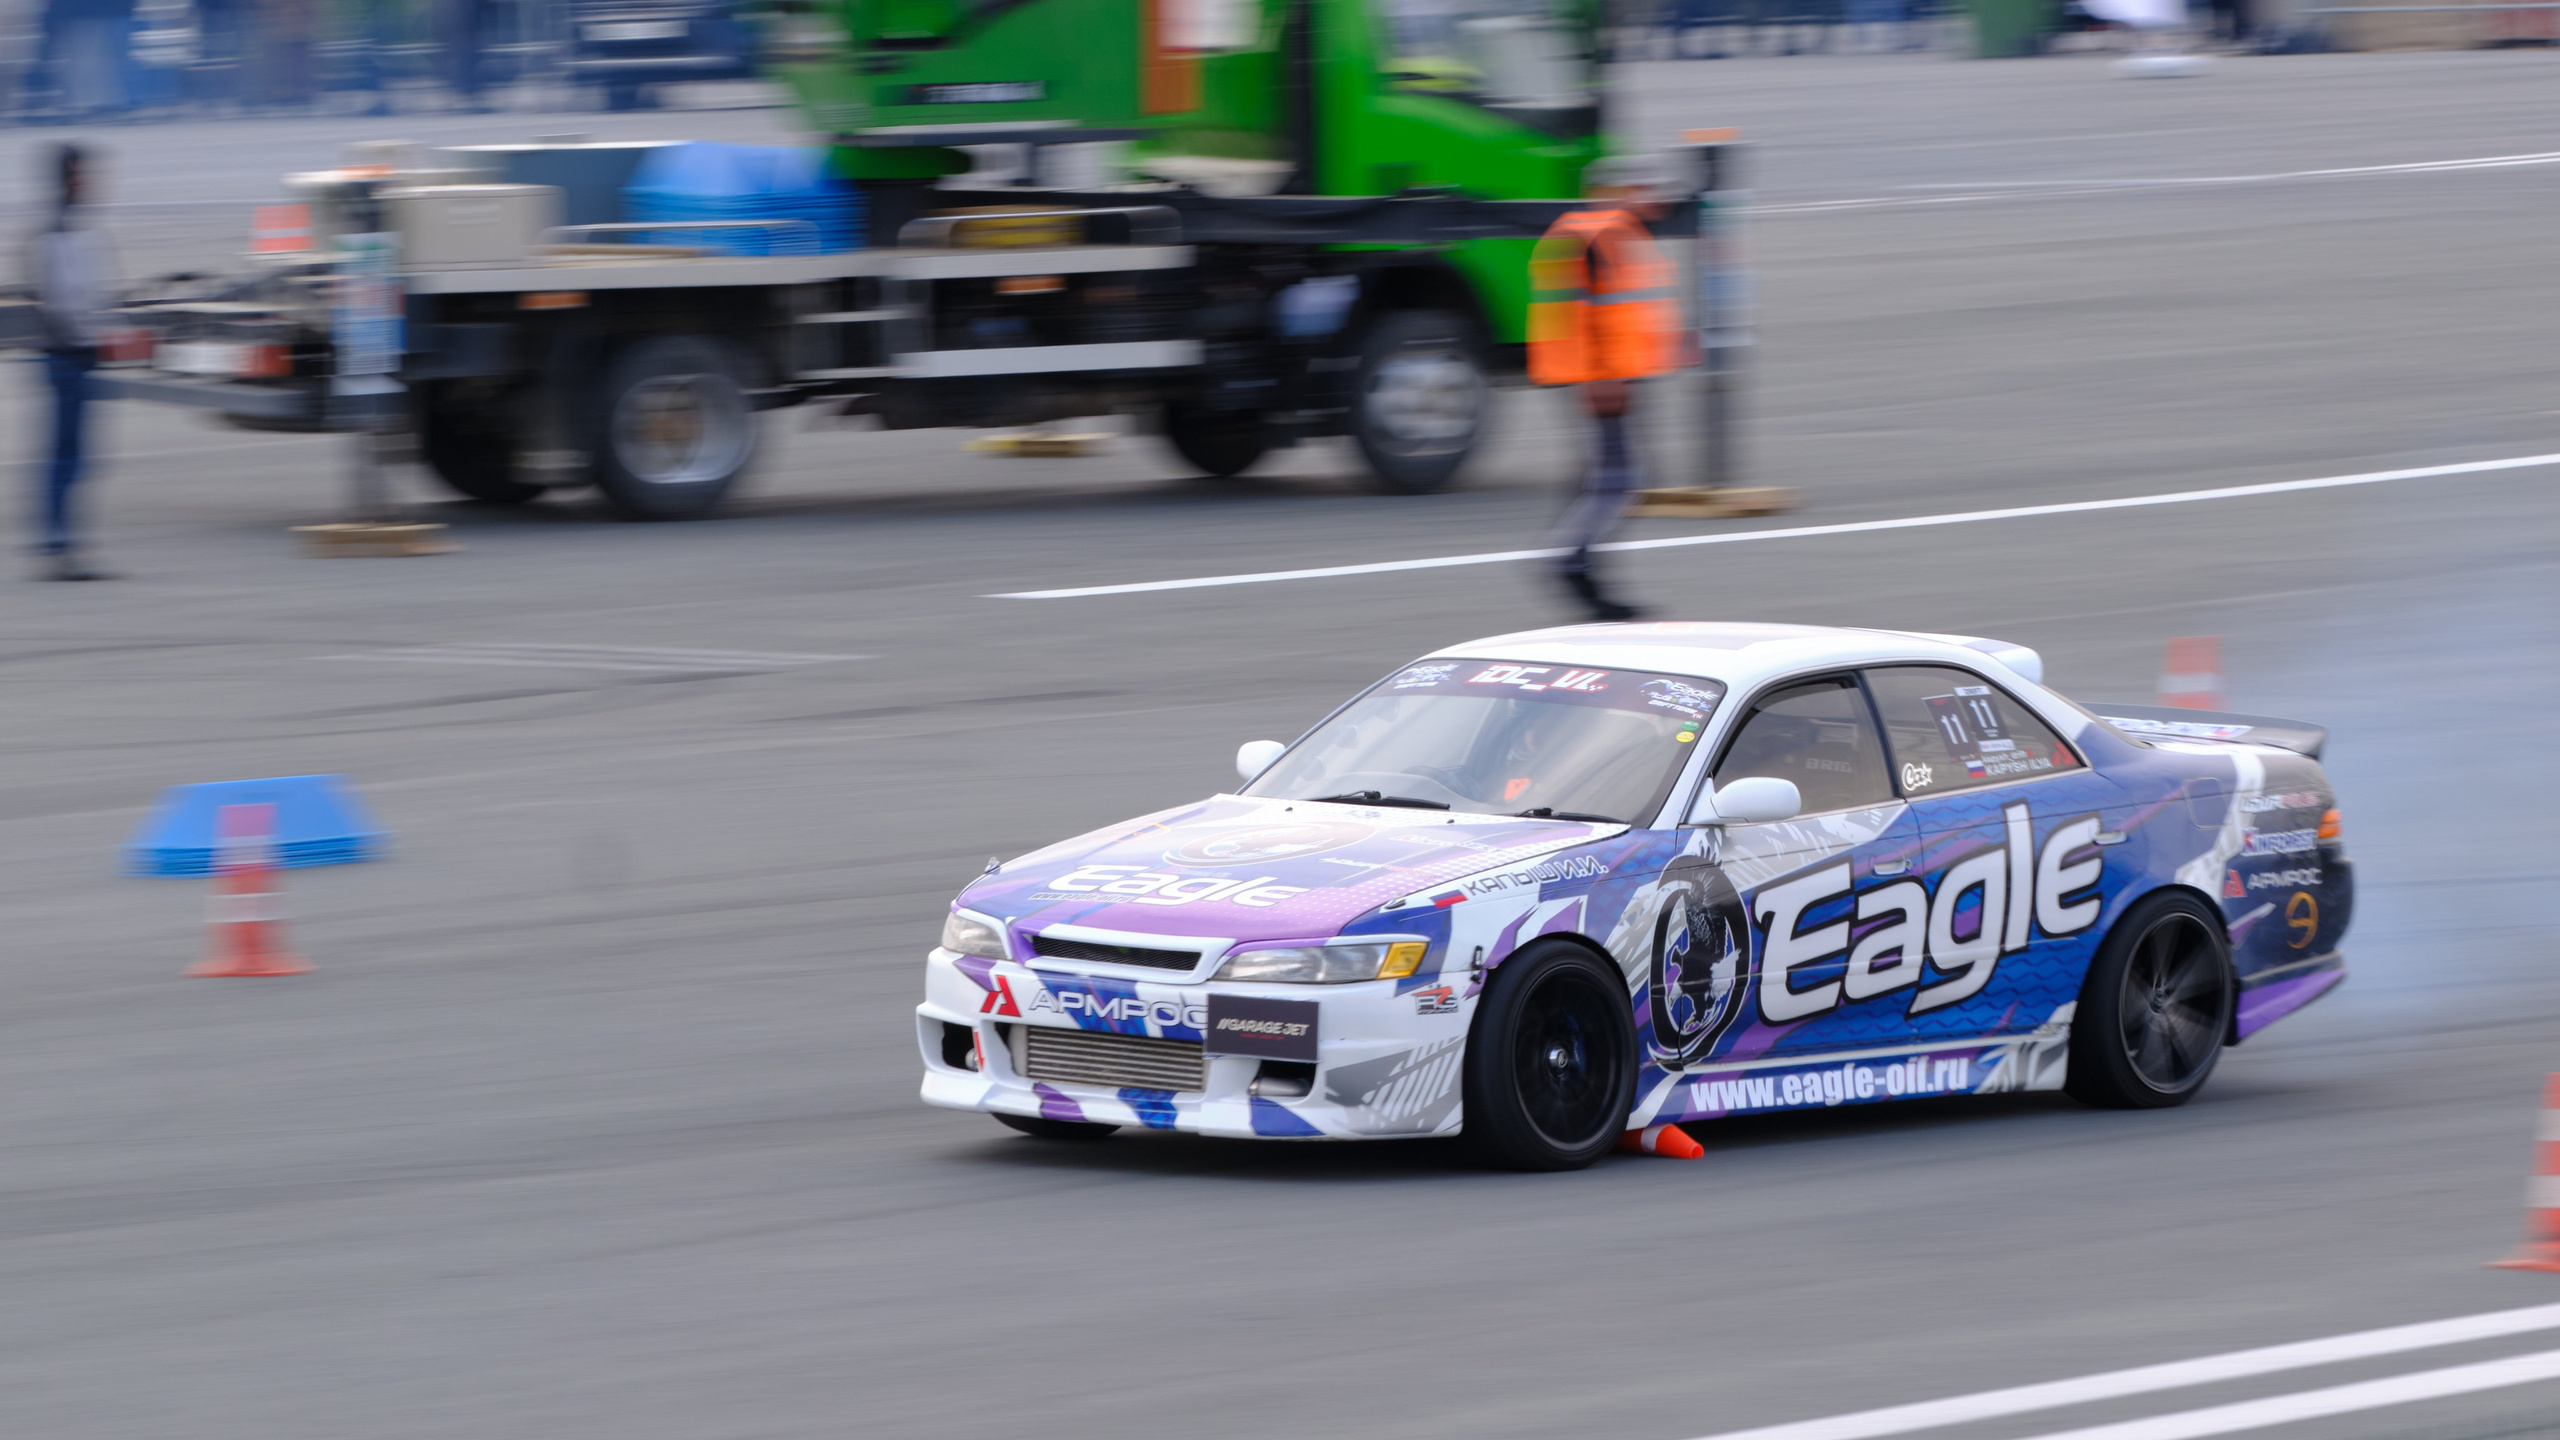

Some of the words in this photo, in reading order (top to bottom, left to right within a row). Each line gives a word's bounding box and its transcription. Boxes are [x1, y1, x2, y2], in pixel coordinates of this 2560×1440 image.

[1940, 713, 1969, 745] 11
[1969, 698, 1998, 729] 11
[1048, 864, 1314, 908] Eagle
[1755, 800, 2102, 1019] Eagle
[1690, 1055, 1969, 1113] www.eagle-oil.ru
